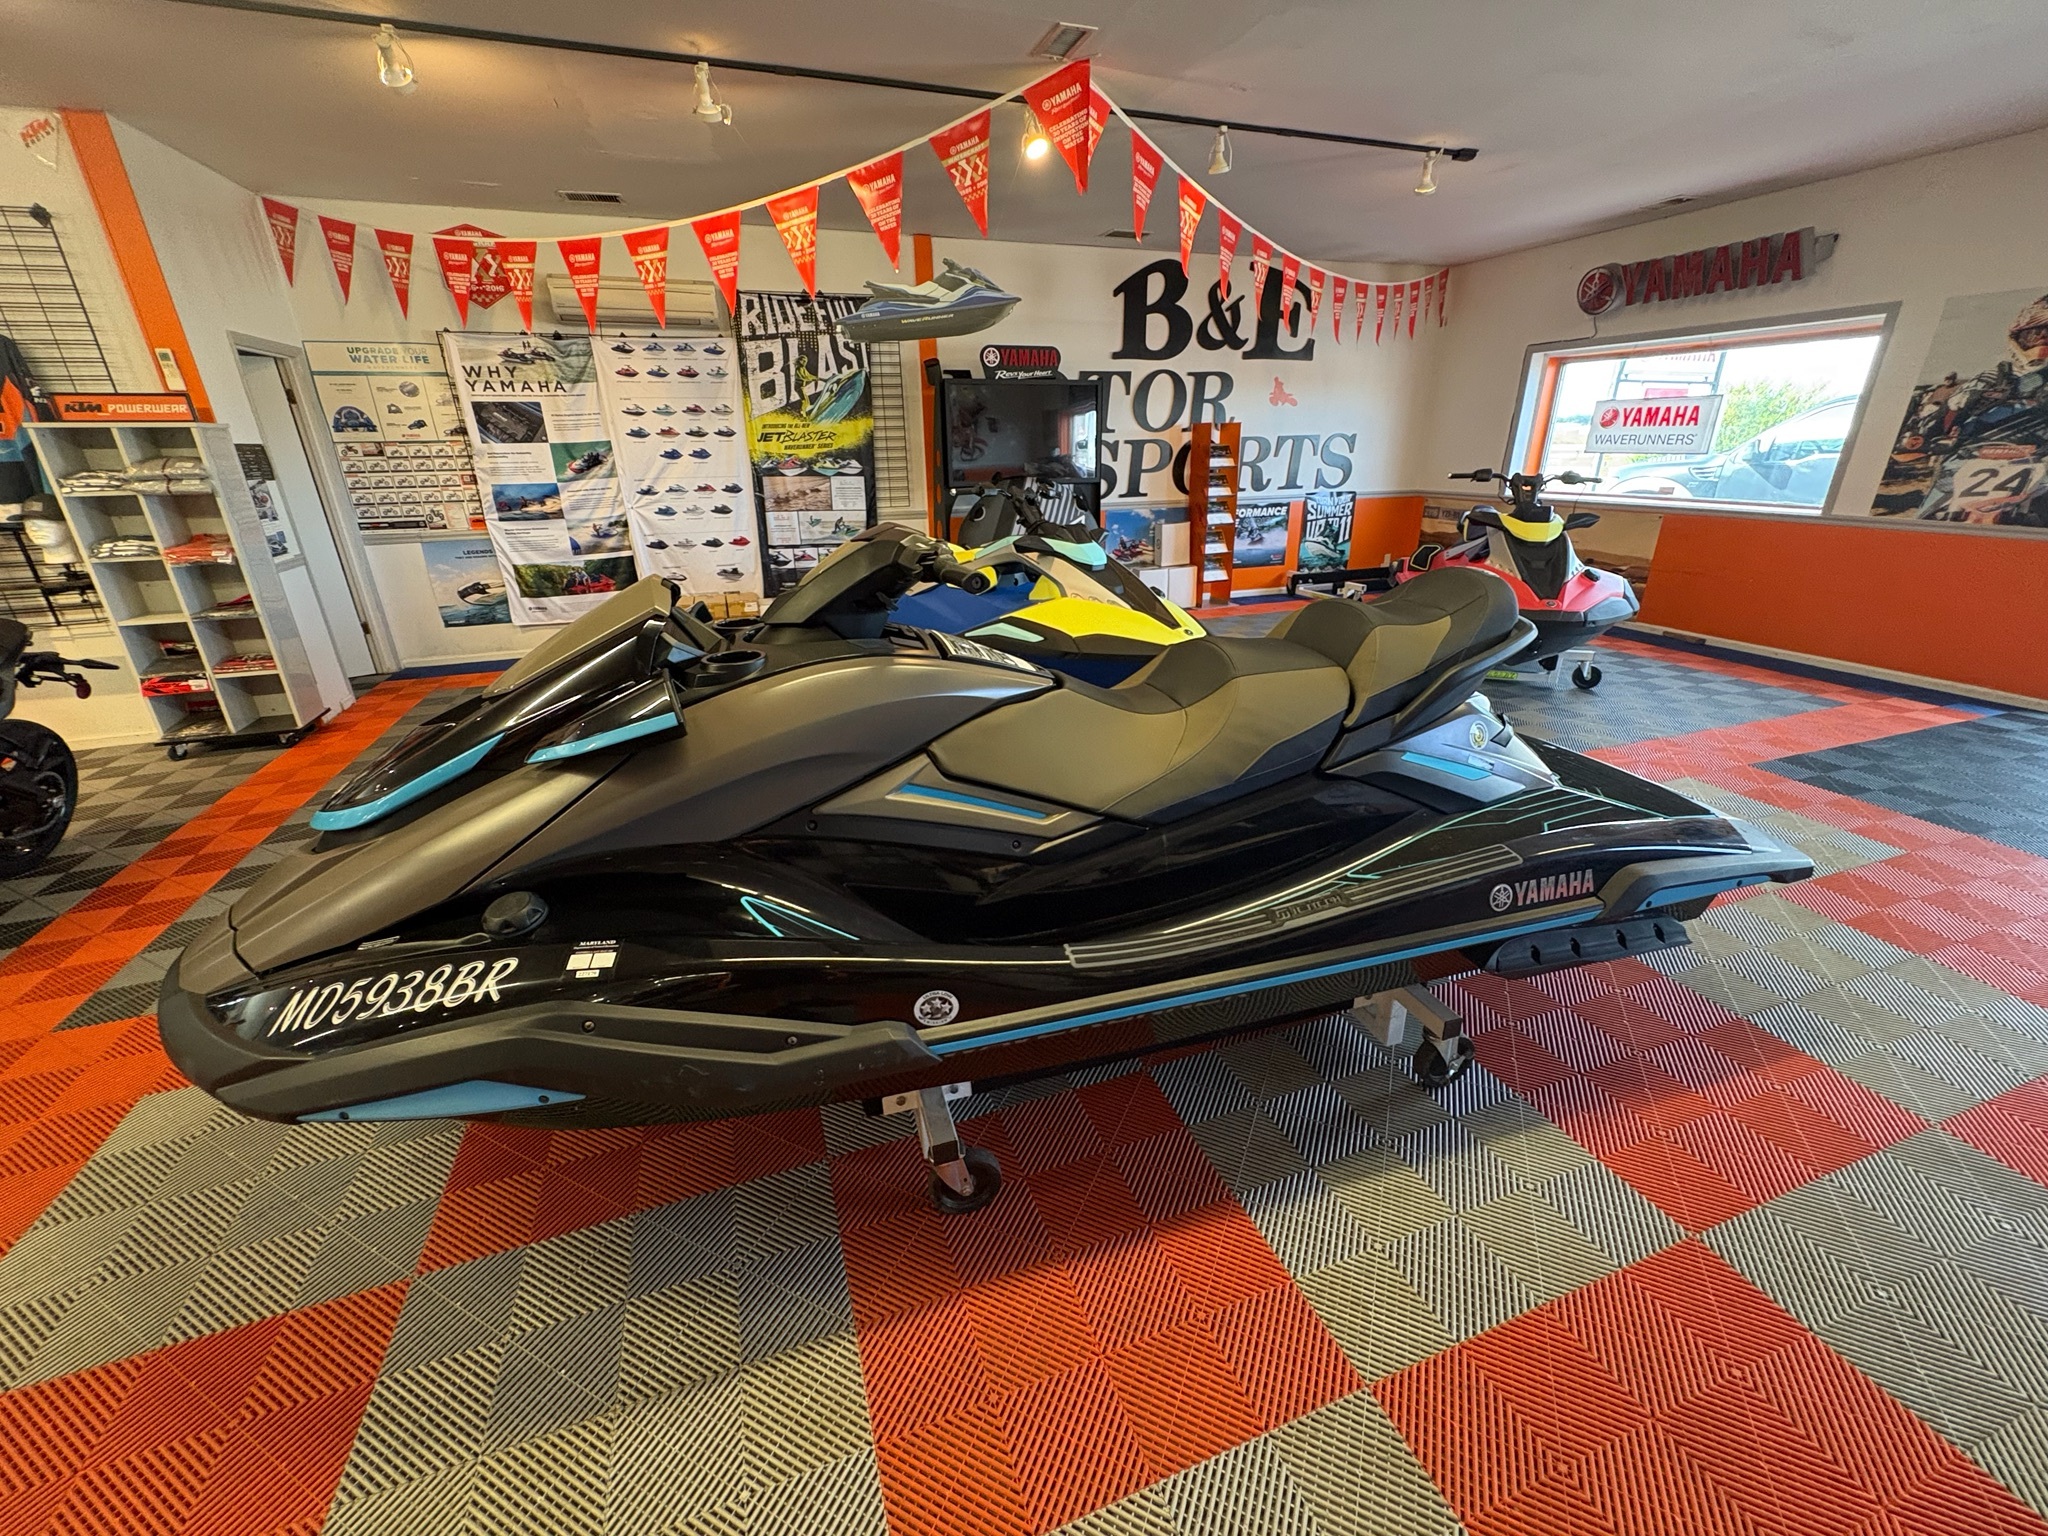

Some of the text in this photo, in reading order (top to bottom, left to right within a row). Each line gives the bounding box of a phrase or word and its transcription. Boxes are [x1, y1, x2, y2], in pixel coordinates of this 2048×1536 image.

[1050, 83, 1082, 107] YAMAHA
[1049, 108, 1088, 131] CELEBRATING
[1060, 120, 1079, 133] YEARS
[1078, 115, 1087, 123] OF
[1053, 120, 1089, 144] INNOVATION
[1062, 130, 1083, 145] ON THE
[956, 135, 980, 152] YAMAHA
[1064, 136, 1085, 150] WATER
[869, 173, 896, 191] YAMAHA
[868, 197, 901, 215] CELEBRATING
[711, 228, 735, 242] YAMAHA
[574, 252, 595, 262] YAMAHA
[1621, 231, 1804, 306] YAMAHA
[1112, 258, 1316, 361] B&E
[346, 346, 428, 355] UPGRADE YOUR
[349, 354, 430, 364] WATER LIFE
[1000, 348, 1059, 367] YAMAHA
[461, 365, 517, 379] WHY
[1017, 370, 1035, 380] Your
[465, 380, 568, 393] YAMAHA
[64, 401, 188, 414] KTM POWERWEAR
[1621, 405, 1700, 427] YAMAHA
[1958, 467, 2034, 499] 24
[1306, 499, 1354, 520] SUMMER
[1514, 868, 1595, 907] YAMAHA
[266, 957, 519, 1038] MD5938BR
